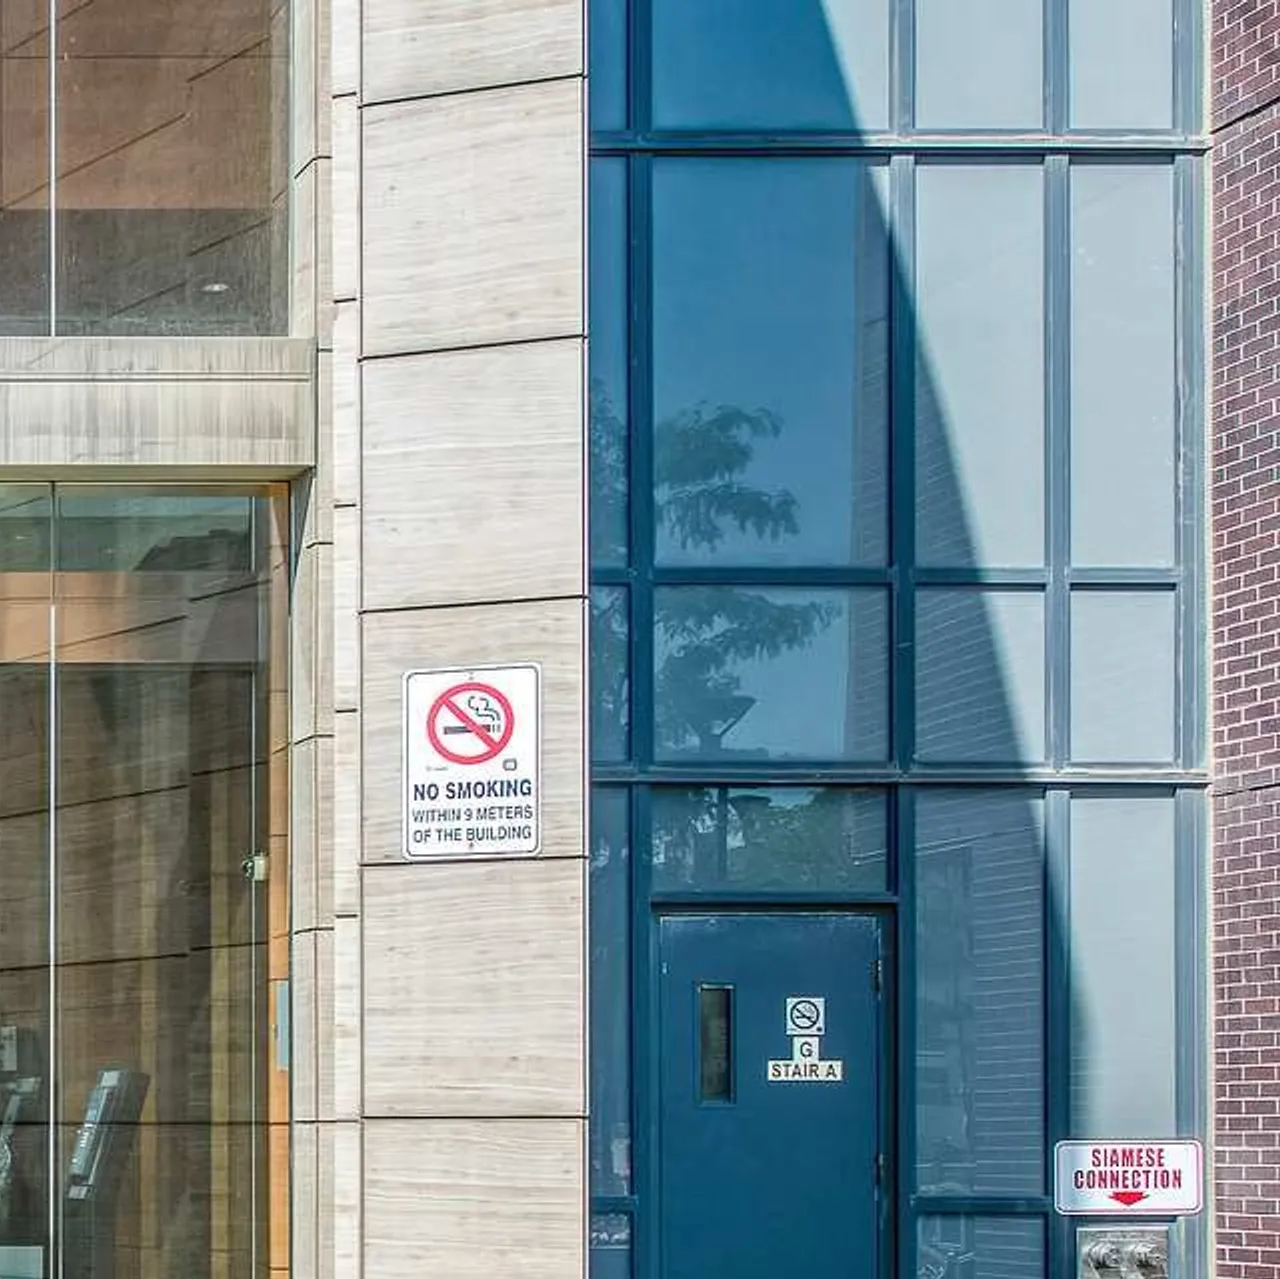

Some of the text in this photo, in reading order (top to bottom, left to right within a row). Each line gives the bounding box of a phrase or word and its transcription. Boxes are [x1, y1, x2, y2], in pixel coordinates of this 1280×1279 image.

[413, 779, 532, 801] NO SMOKING
[412, 804, 533, 823] WITHIN 9 METERS
[413, 825, 532, 843] OF THE BUILDING
[800, 1041, 813, 1058] G
[771, 1063, 837, 1078] STAIR A
[1091, 1147, 1166, 1168] SIAMESE
[1073, 1169, 1182, 1190] CONNECTION
